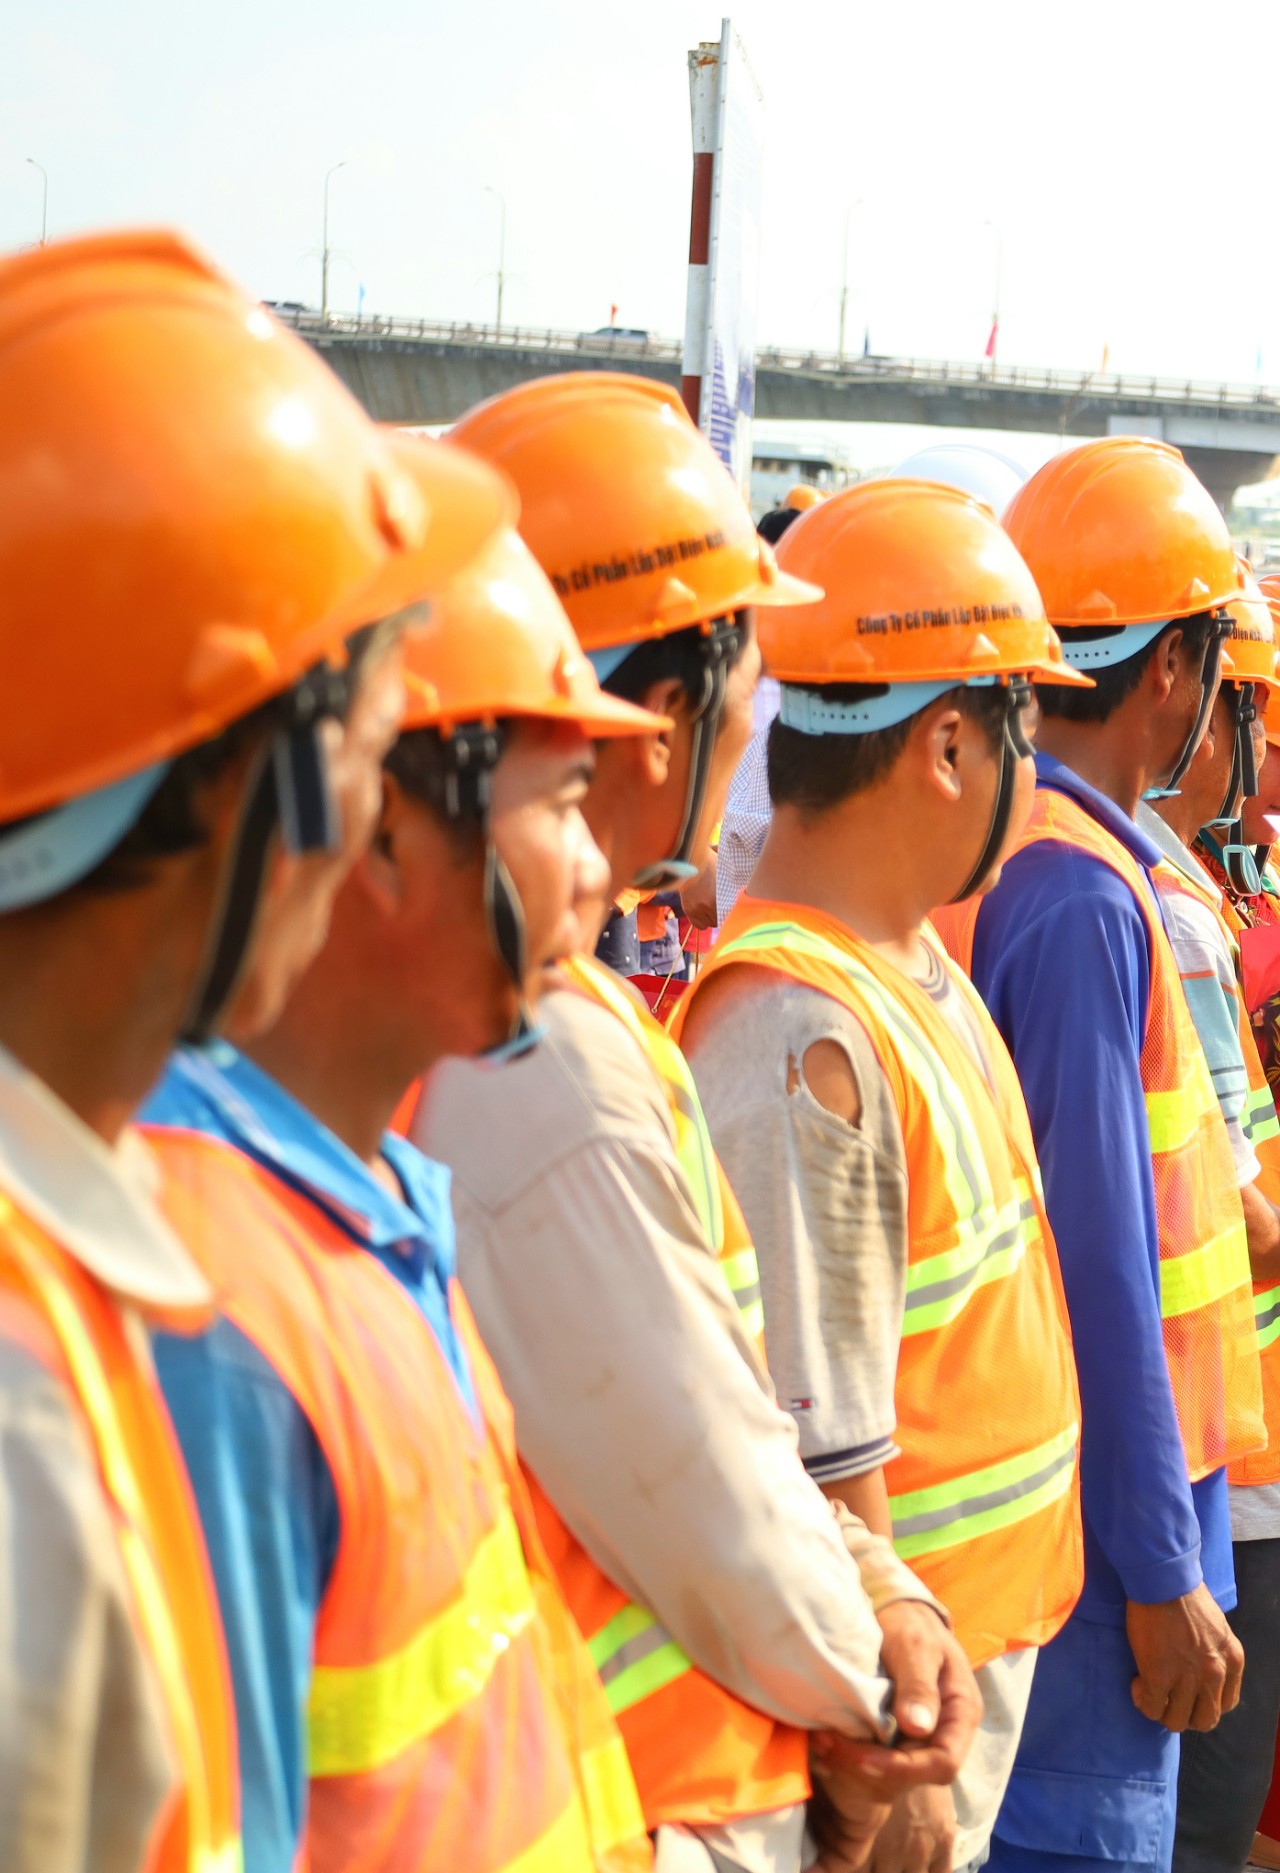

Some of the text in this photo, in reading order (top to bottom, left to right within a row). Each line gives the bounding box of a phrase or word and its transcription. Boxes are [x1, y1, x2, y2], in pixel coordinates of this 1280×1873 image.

[857, 614, 888, 635] Công
[889, 612, 902, 633] Ty
[904, 607, 920, 630] Cổ
[922, 606, 949, 628] Phần
[953, 606, 972, 627] Lắp
